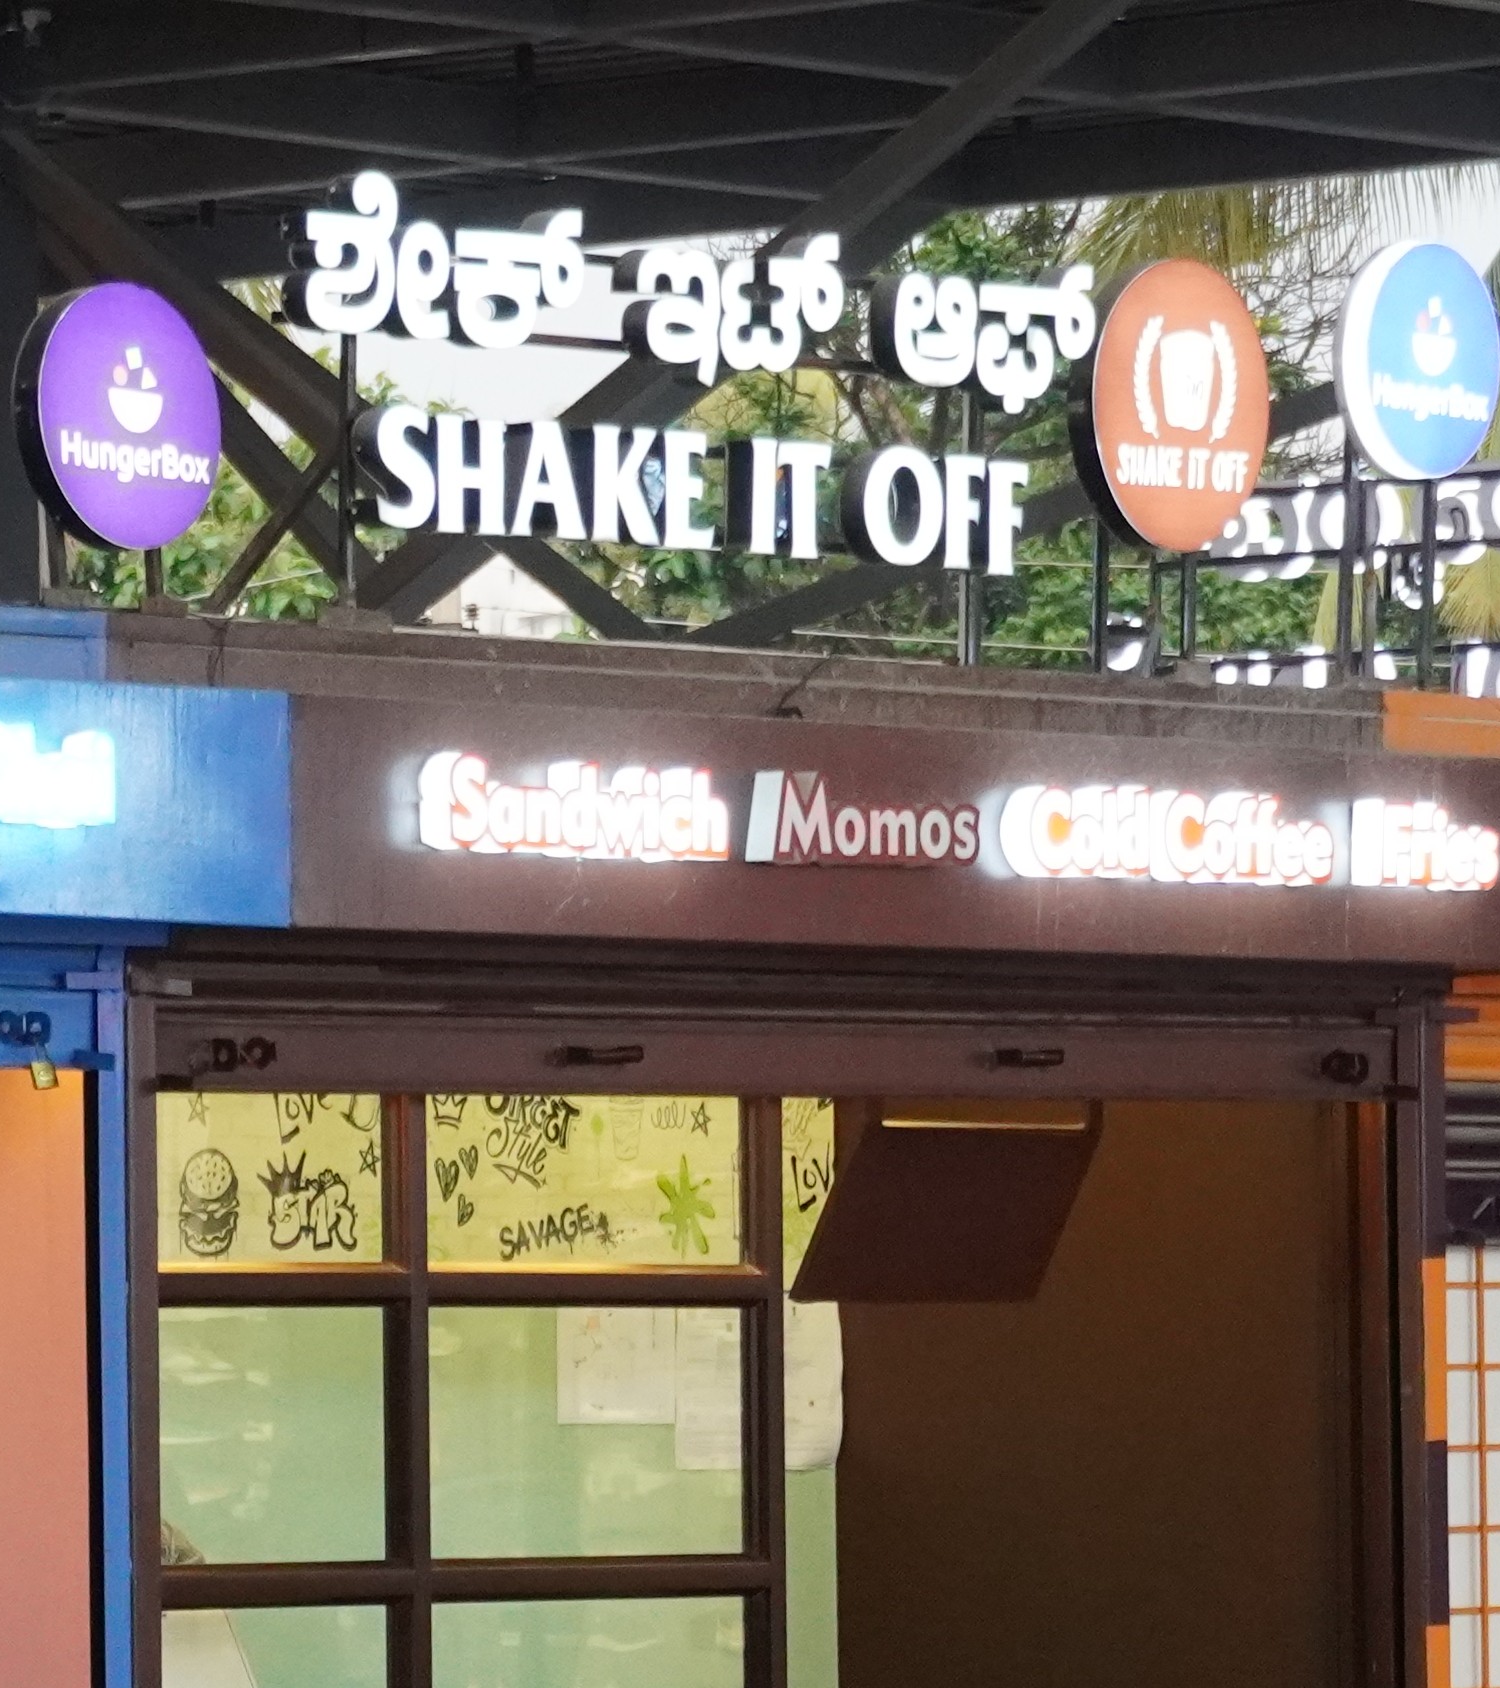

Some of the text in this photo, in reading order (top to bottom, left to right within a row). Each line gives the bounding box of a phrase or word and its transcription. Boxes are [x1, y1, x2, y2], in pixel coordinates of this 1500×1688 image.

[1372, 371, 1490, 424] HungerBox
[59, 429, 211, 487] HungerBox
[1116, 443, 1249, 494] SHAKE IT OFF
[374, 407, 1030, 577] SHAKE IT OFF
[422, 750, 1500, 892] Sandwich Momos Cold Coffee Fries
[267, 1180, 359, 1252] STAR
[499, 1203, 595, 1263] SAVAGE
